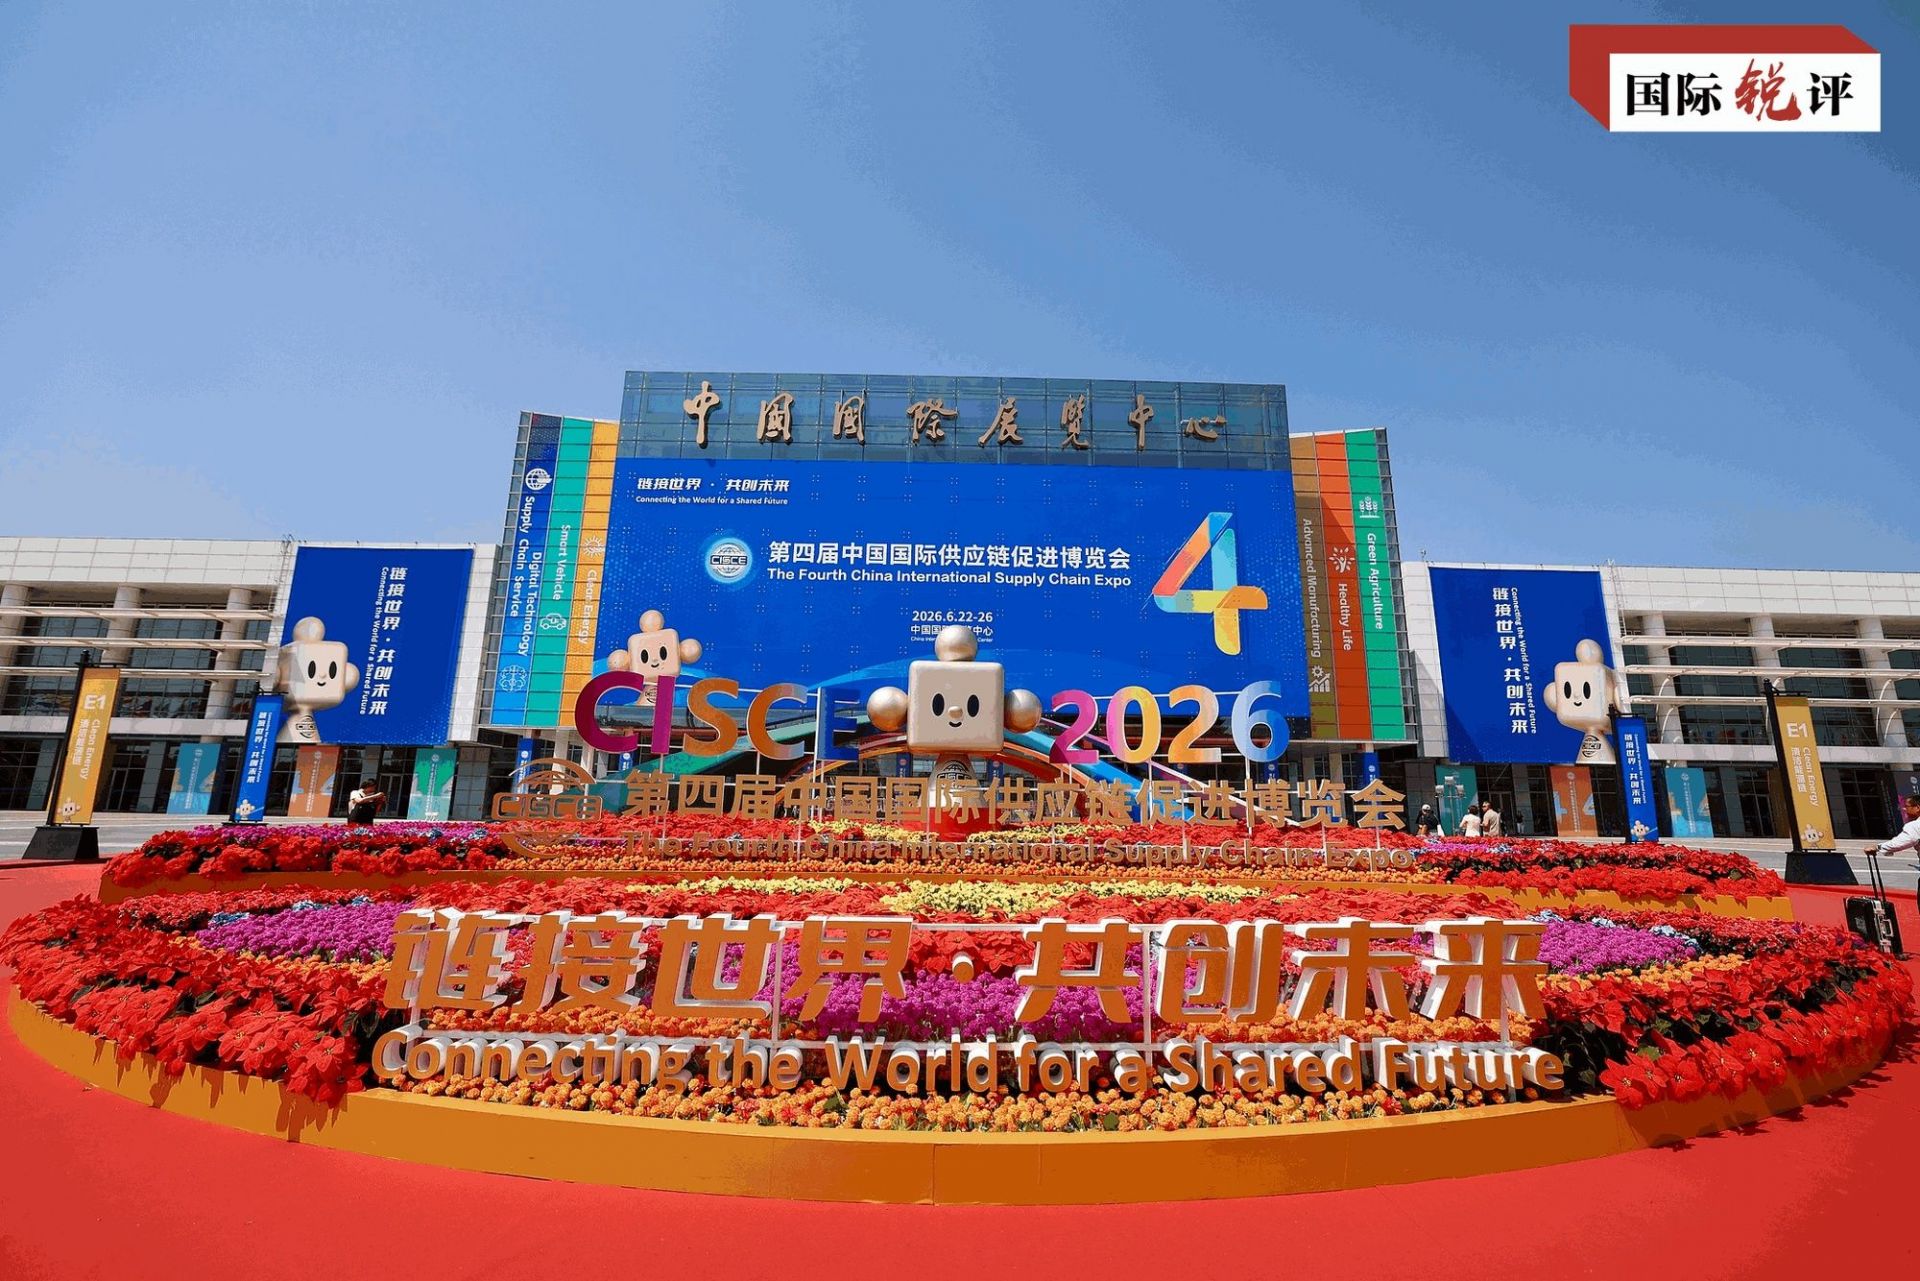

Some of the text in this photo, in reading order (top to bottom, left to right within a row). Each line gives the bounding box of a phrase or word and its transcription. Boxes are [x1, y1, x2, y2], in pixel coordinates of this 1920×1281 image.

[635, 495, 677, 505] Connecting
[678, 495, 691, 503] the
[692, 496, 716, 504] World
[717, 496, 729, 504] for
[735, 496, 762, 505] Shared
[764, 496, 788, 505] Future
[510, 496, 535, 617] Supply Chain Service
[552, 524, 571, 600] Smart Vehicle
[711, 556, 747, 565] CISCE
[768, 540, 1131, 570] 第四届中国国际供应链促进博览会
[375, 566, 389, 606] Connecting
[767, 567, 1131, 588] The Fourth China International Supply Chain Expo
[1303, 518, 1321, 658] Advanced Manufacturing
[1367, 533, 1383, 630] Green Agriculture
[374, 607, 382, 619] the
[517, 552, 542, 657] Digital Technology
[577, 569, 597, 645] Clean Energy
[912, 610, 993, 622] 2026.6.22-26
[1338, 583, 1352, 651] Healthy Life
[1511, 587, 1522, 626] Connecting
[370, 620, 381, 643] World
[1516, 626, 1524, 639] the
[368, 644, 378, 656] for
[1519, 640, 1529, 662] World
[364, 663, 374, 689] Shared
[1522, 663, 1530, 676] for
[83, 694, 106, 710] E1
[360, 690, 370, 715] Future
[1525, 682, 1535, 709] Shared
[574, 670, 860, 762] CISCE
[1048, 680, 1290, 765] 2026
[1529, 709, 1537, 734] Future
[1786, 722, 1808, 738] E1
[80, 719, 101, 780] Clean Energy
[1803, 746, 1819, 806] Clean Energy
[620, 768, 1405, 828] 第四届中国国际供应链促进博览会
[621, 831, 1413, 872] The Fourth China International Supply Chain Expo
[372, 1029, 1565, 1093] Connecting the World for a Shared Future
